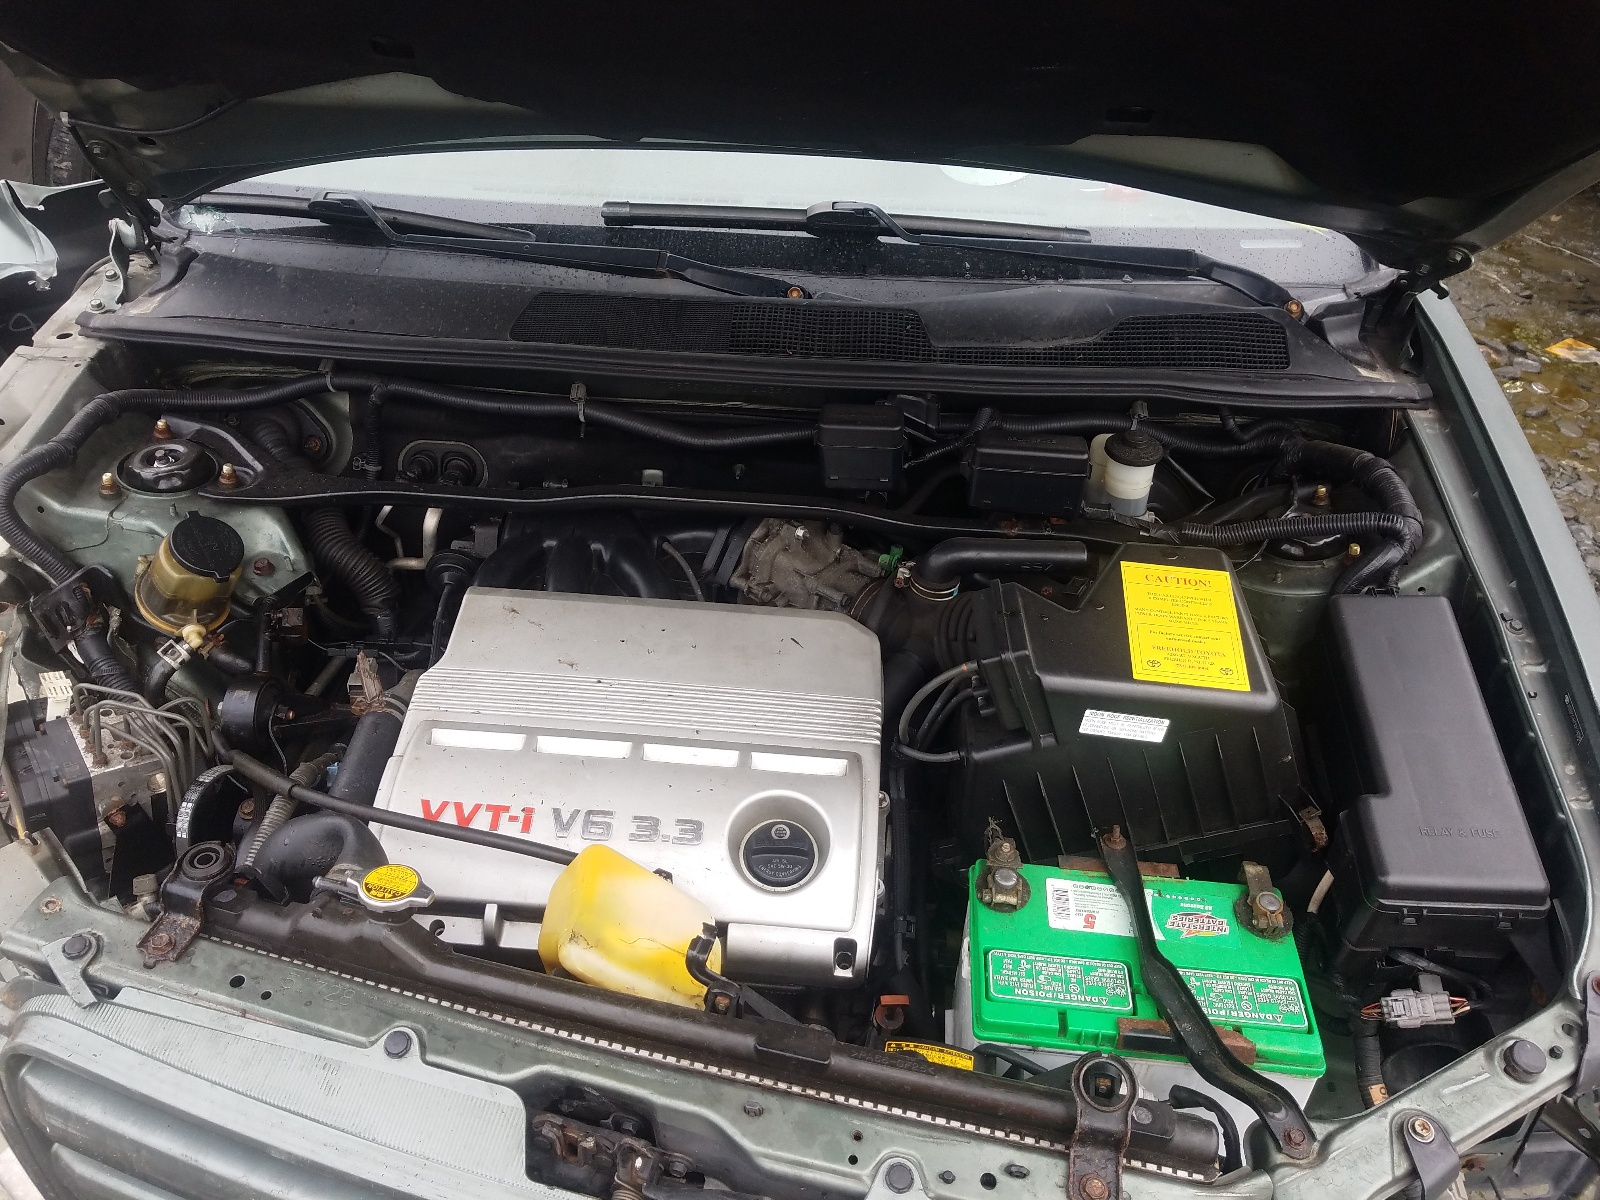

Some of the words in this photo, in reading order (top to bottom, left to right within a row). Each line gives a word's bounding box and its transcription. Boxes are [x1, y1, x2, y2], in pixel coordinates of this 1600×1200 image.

[1145, 574, 1212, 587] CAUTION!
[551, 807, 616, 842] V6
[628, 815, 705, 846] 3.3
[1419, 826, 1453, 837] RELAY
[1470, 828, 1499, 838] FUSE
[366, 883, 402, 896] CAUTION
[1083, 914, 1097, 929] 5
[1168, 921, 1227, 933] INTERSTATE
[1172, 915, 1224, 926] BATTERIES
